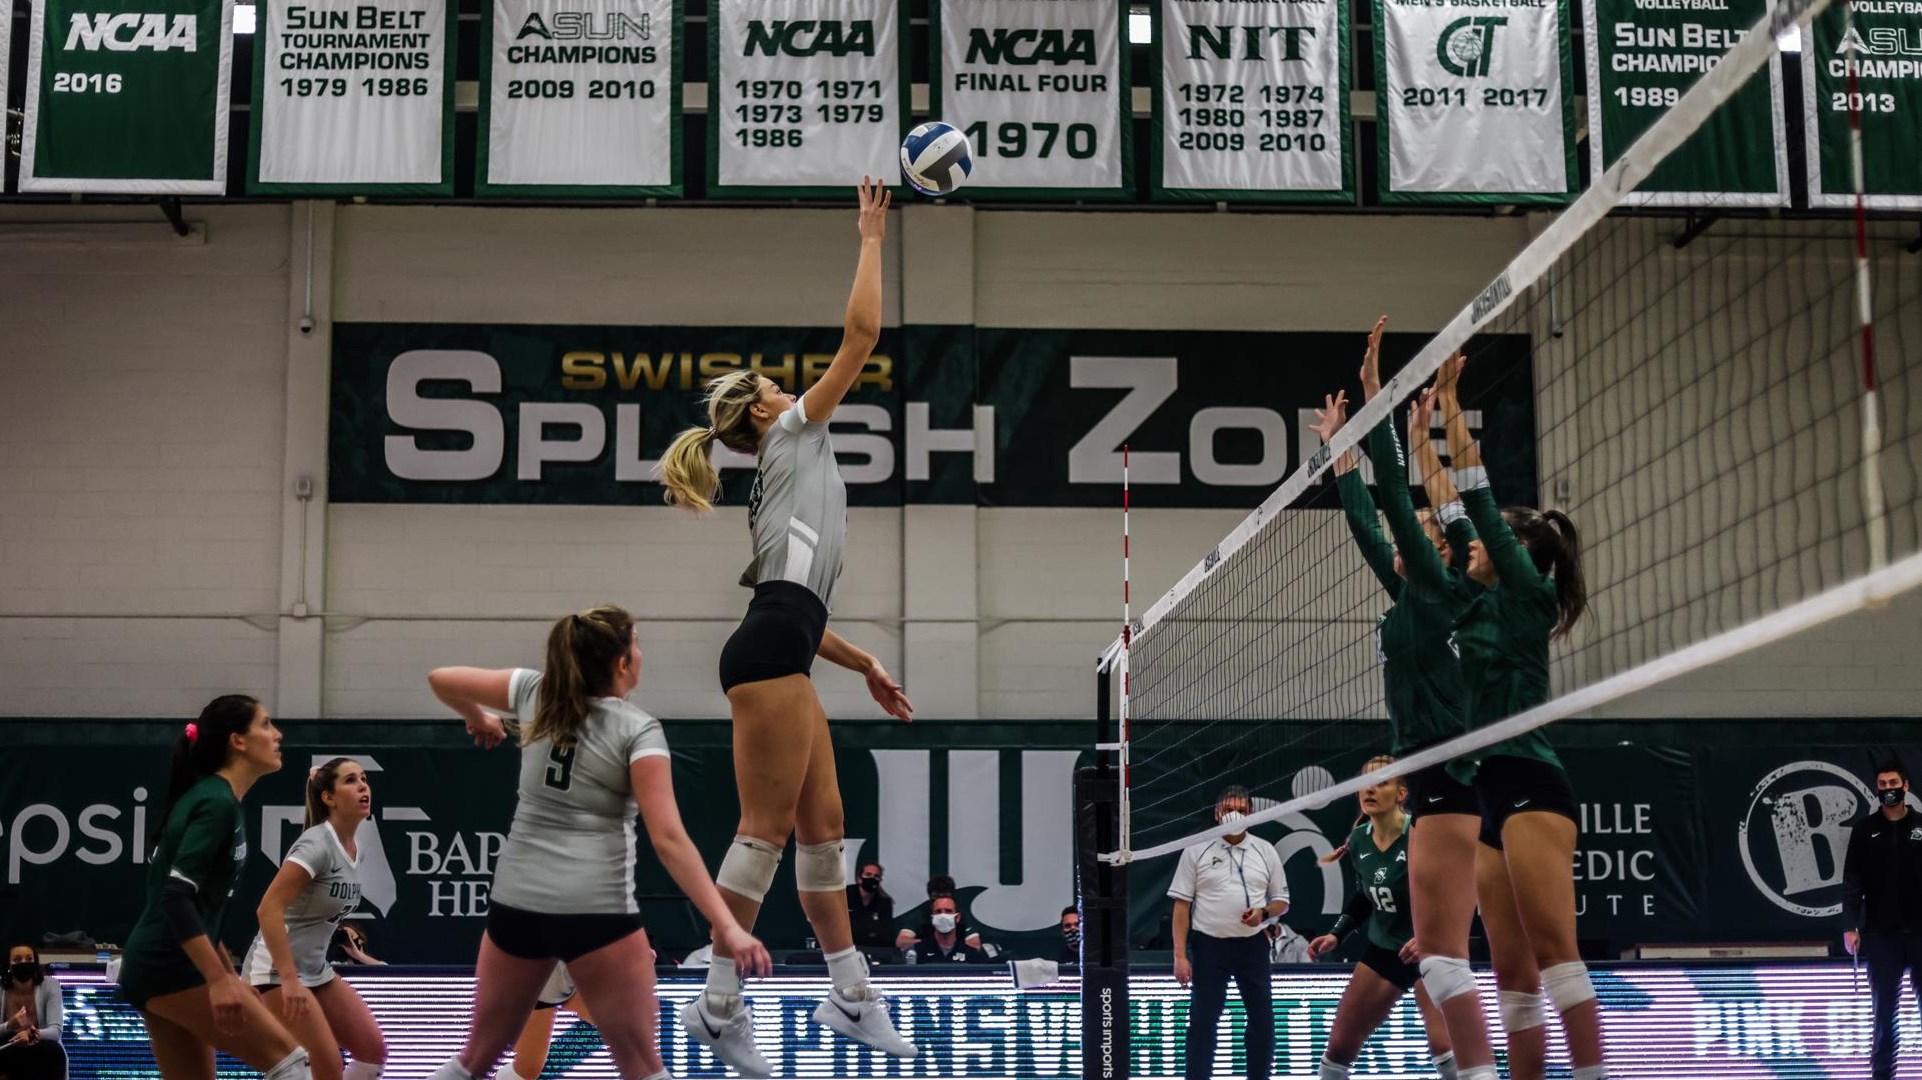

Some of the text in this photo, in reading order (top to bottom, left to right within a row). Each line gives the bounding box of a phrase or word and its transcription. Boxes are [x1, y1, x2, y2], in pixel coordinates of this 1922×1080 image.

[1635, 0, 1729, 10] VOLLEYBALL
[1849, 1, 1922, 14] VOLLEYBA
[286, 6, 426, 30] SUN BELT
[516, 12, 650, 40] ASUN
[63, 13, 197, 52] NCAA
[281, 33, 430, 49] TOURNAMENT
[743, 20, 874, 57] NCAA
[1615, 22, 1676, 48] SUN
[1835, 27, 1922, 55] ASU
[965, 28, 1097, 66] NCAA
[1185, 25, 1316, 61] NIT
[280, 52, 430, 71] CHAMPIONS
[507, 46, 656, 64] CHAMPIONS
[1828, 59, 1922, 79] CHAMPI
[53, 72, 122, 93] 2016
[280, 78, 428, 97] 1979 1986
[507, 80, 655, 99] 2009 2010
[735, 80, 882, 99] 1970 1971
[955, 73, 1107, 93] FINAL FOUR
[1178, 84, 1324, 104] 1972 1974
[1403, 88, 1547, 107] 2011 2017
[1614, 87, 1680, 107] 1989
[1832, 92, 1895, 112] 2013
[735, 104, 884, 123] 1973 1979
[1178, 108, 1324, 128] 1980 1987
[735, 129, 803, 148] 1986
[965, 120, 1097, 160] 1970
[1179, 132, 1325, 152] 2009 2010
[544, 735, 578, 792] 9
[0, 786, 148, 885] psi
[1369, 886, 1397, 913] 12
[1100, 987, 1114, 1079] sports imports
